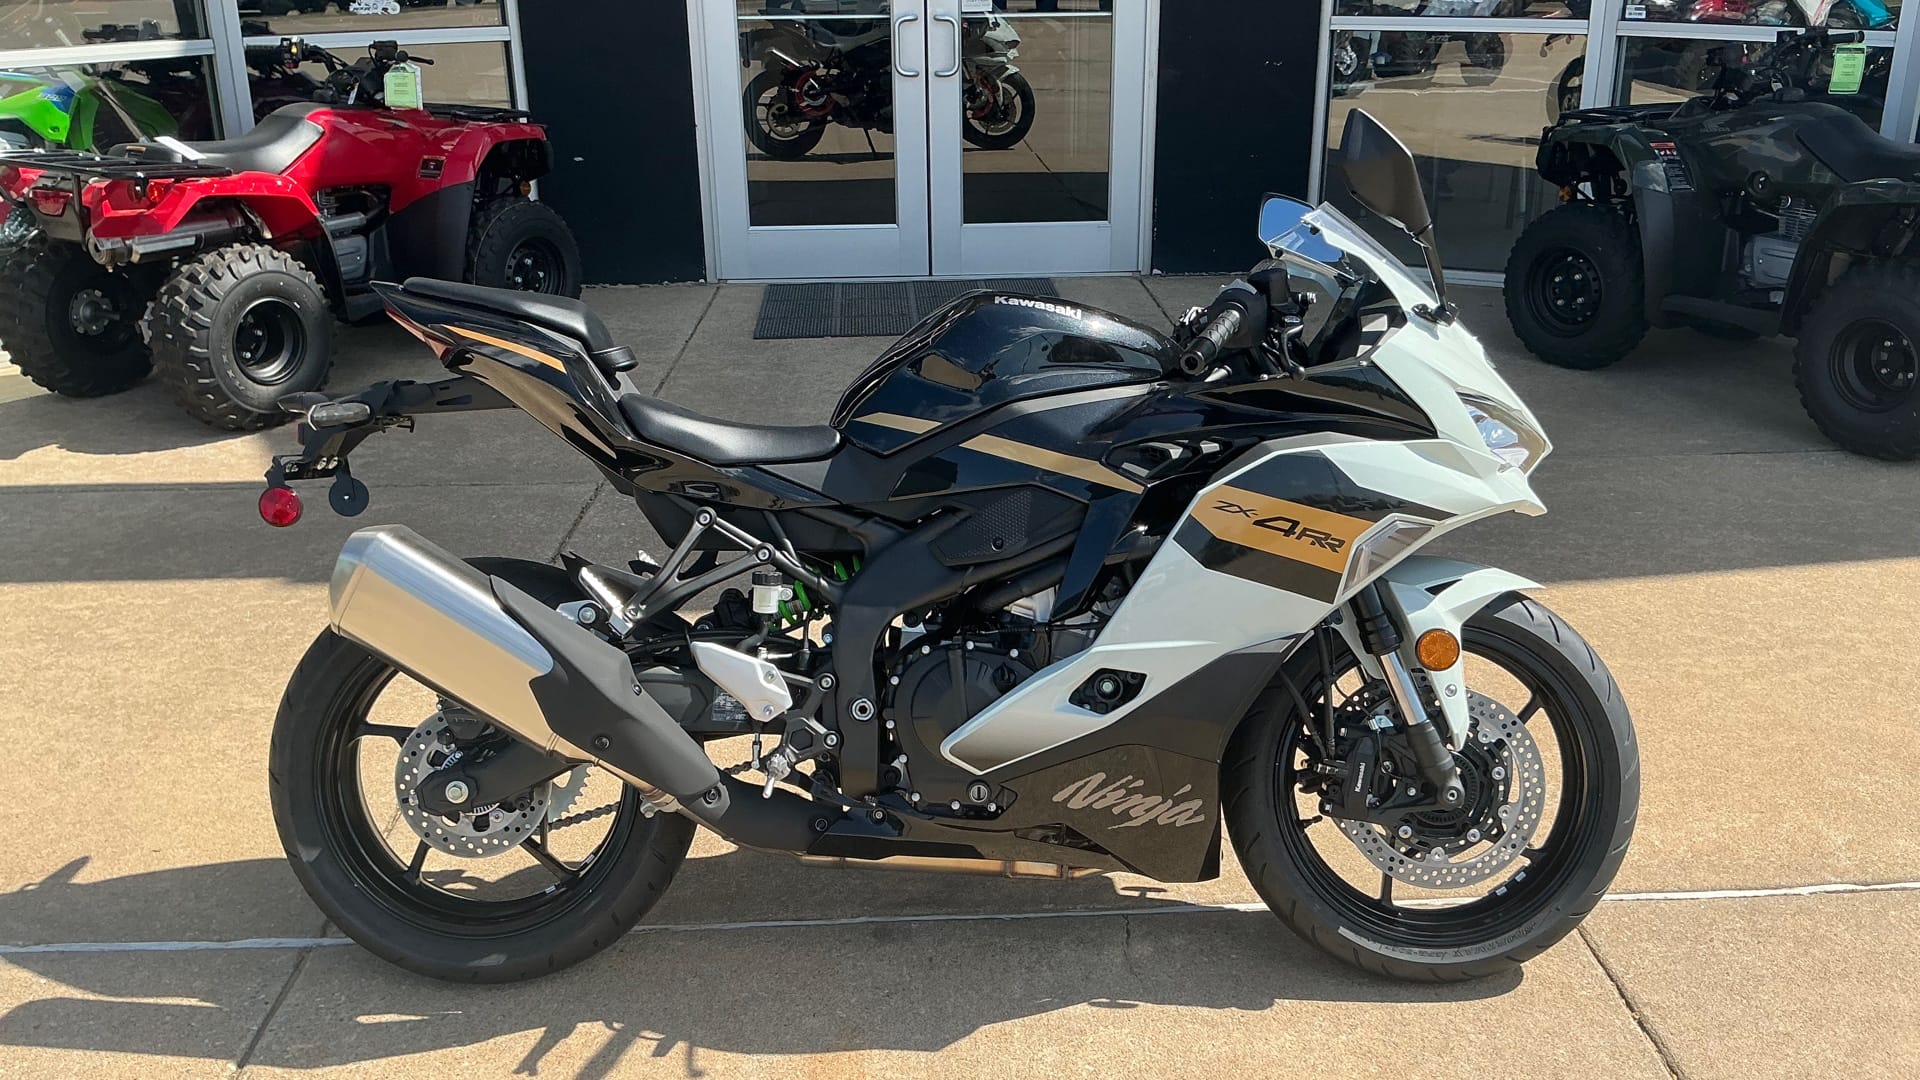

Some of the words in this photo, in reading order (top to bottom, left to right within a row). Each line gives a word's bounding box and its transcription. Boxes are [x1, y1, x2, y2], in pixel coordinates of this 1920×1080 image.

[994, 296, 1082, 320] Kawasaki
[1211, 500, 1346, 554] ZX-4RR
[1354, 762, 1366, 793] Kawasaki
[1052, 772, 1205, 830] Ninja
